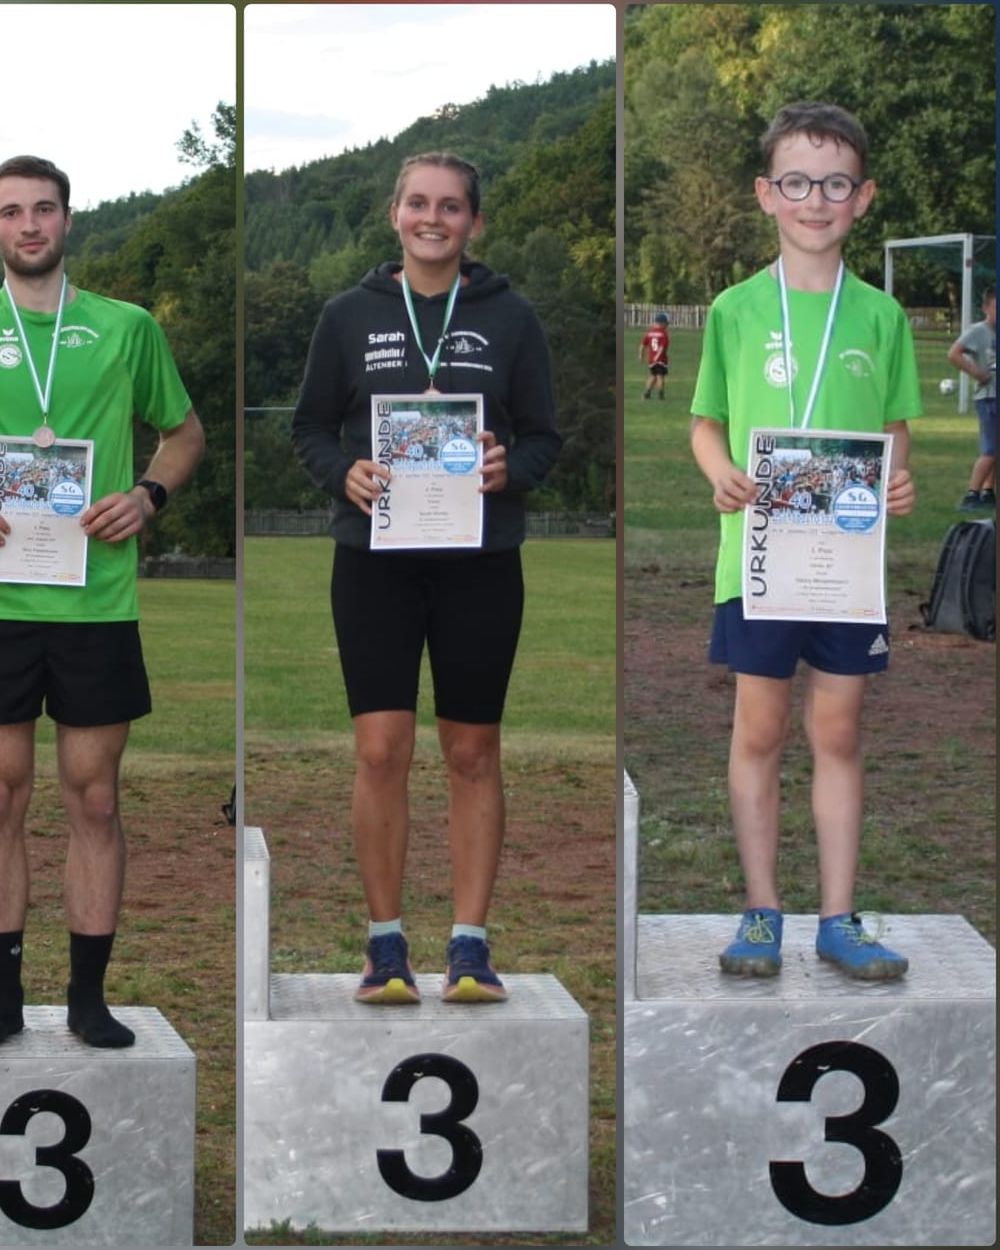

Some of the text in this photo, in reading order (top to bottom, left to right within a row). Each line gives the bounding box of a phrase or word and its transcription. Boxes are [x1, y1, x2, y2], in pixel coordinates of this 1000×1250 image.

[368, 331, 405, 344] Sarah
[750, 436, 775, 597] URKUNDE
[376, 1053, 483, 1202] 3
[769, 1040, 904, 1227] 3
